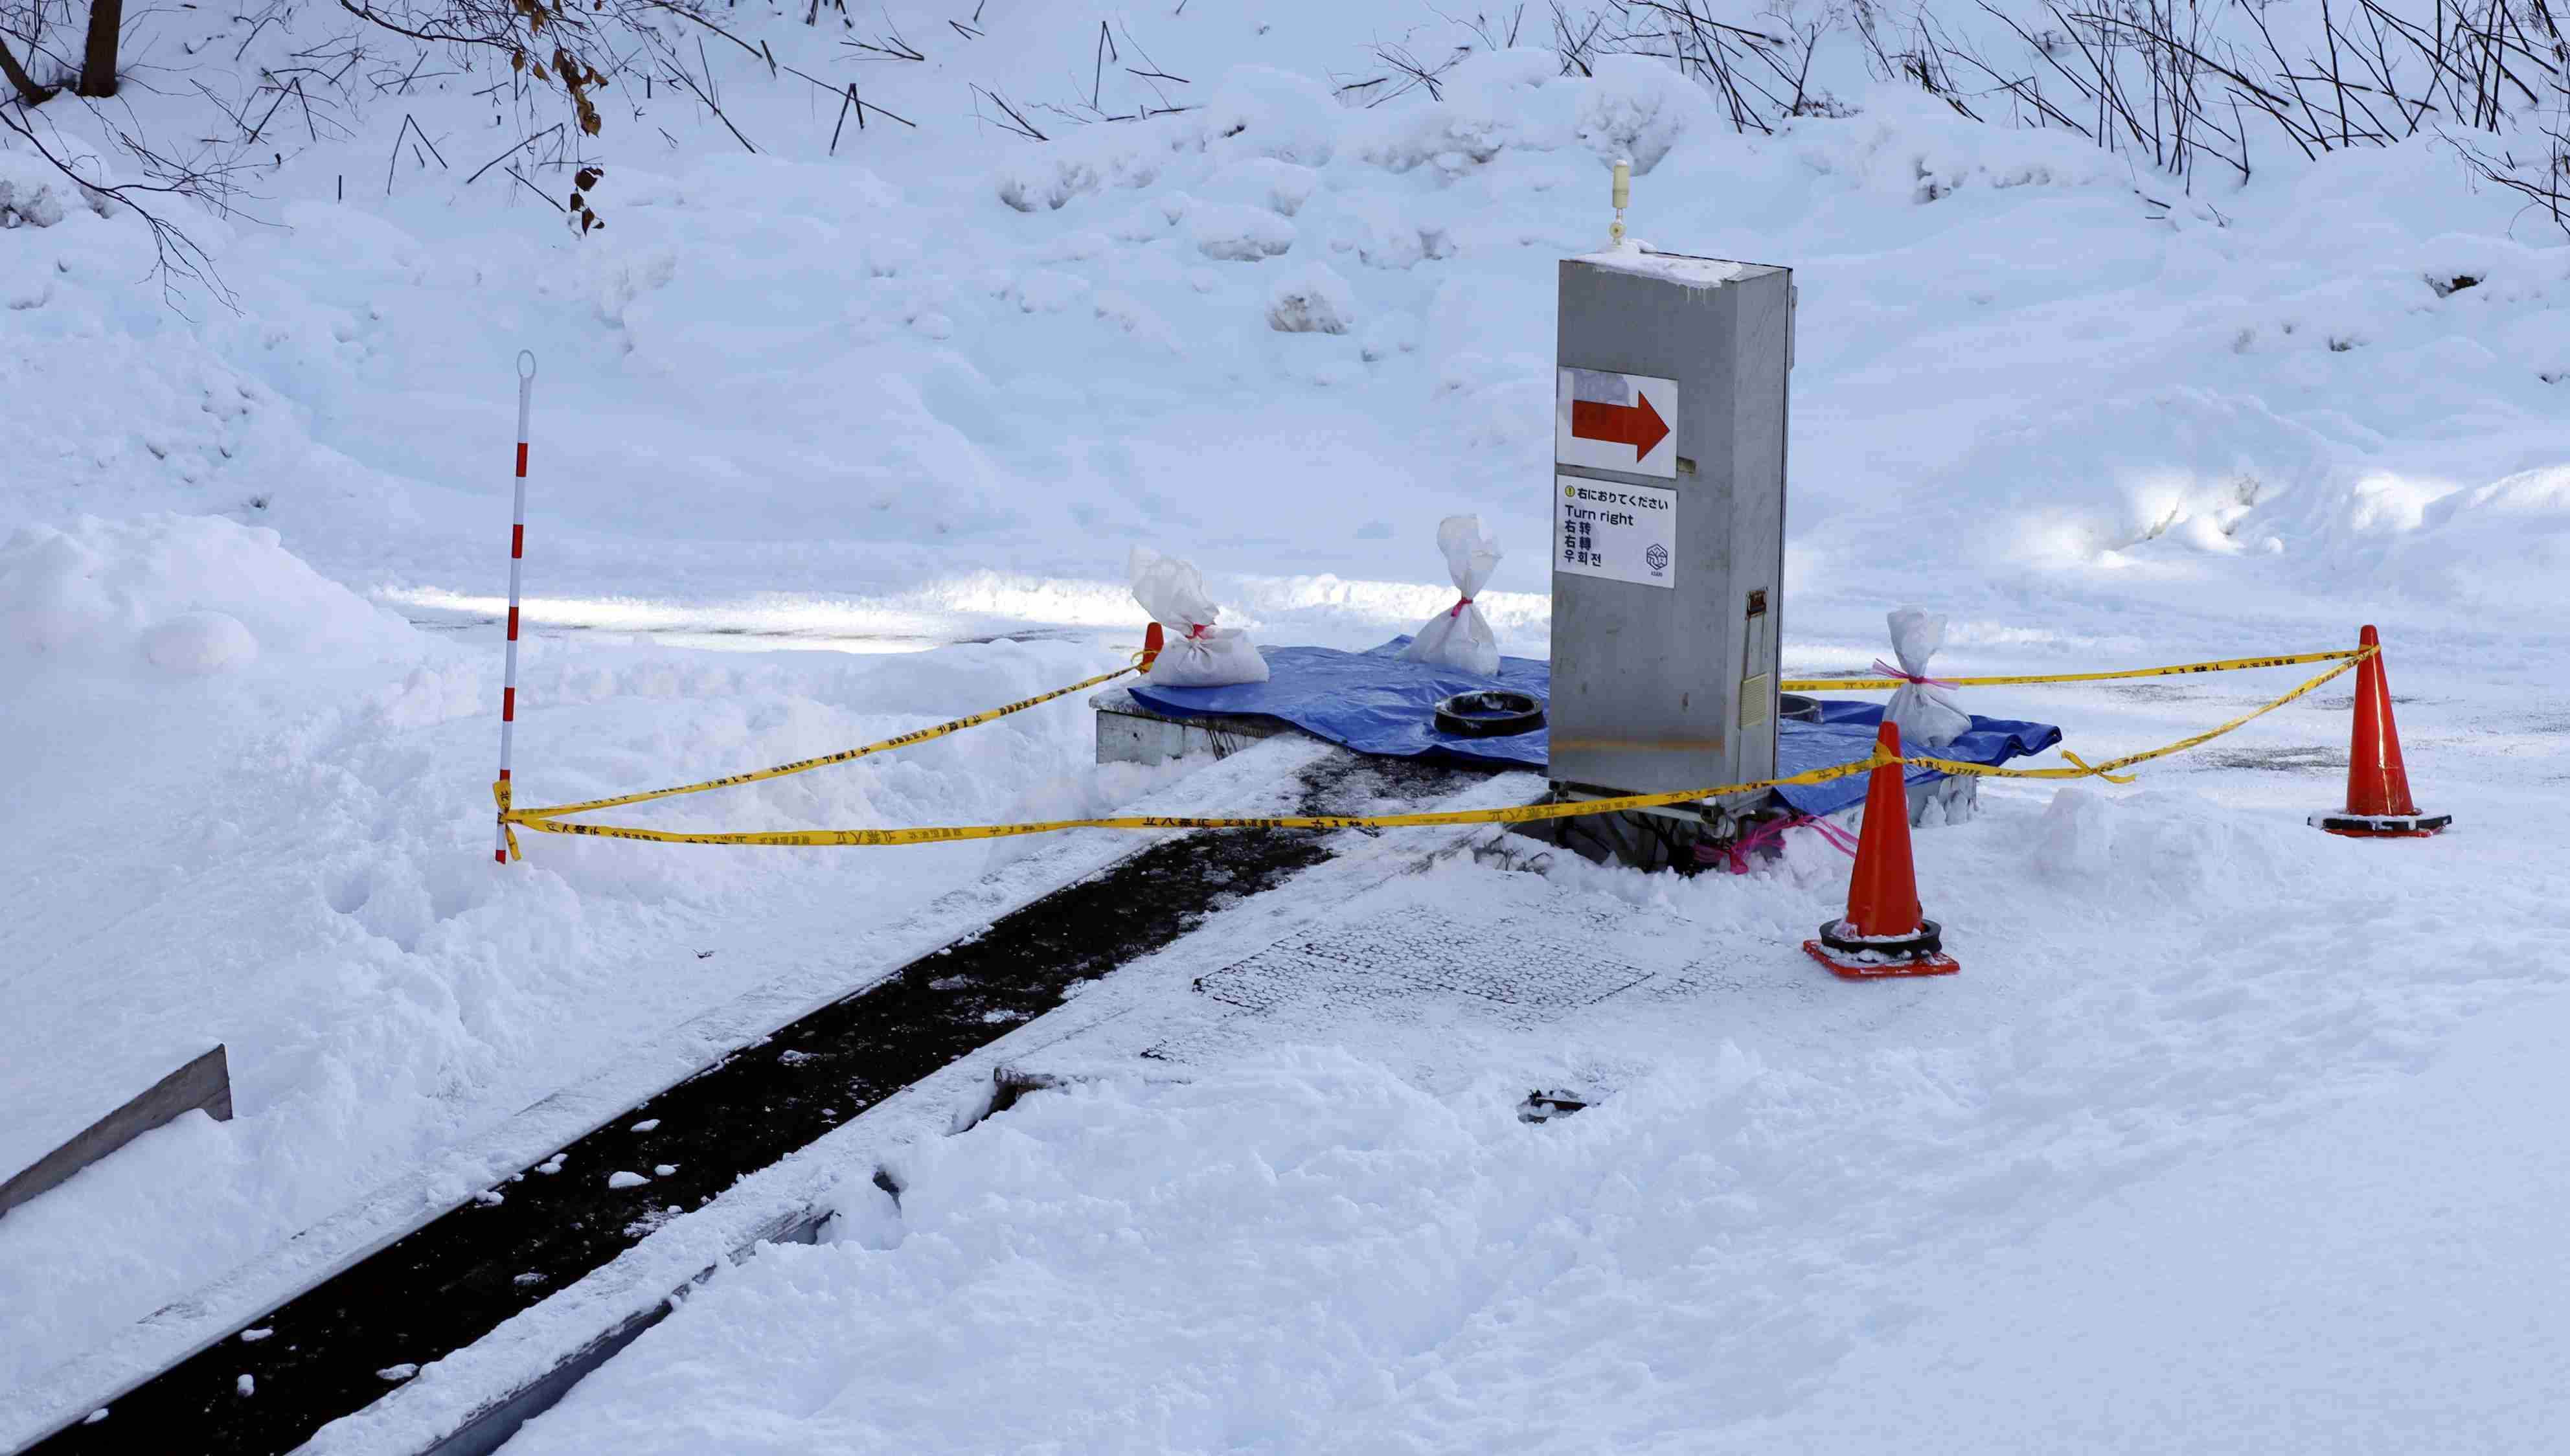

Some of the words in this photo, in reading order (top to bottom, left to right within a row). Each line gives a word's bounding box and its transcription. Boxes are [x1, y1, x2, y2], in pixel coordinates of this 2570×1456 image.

[1577, 487, 1668, 510] 右におりてください
[1565, 504, 1596, 521] Turn
[1600, 510, 1634, 526] right
